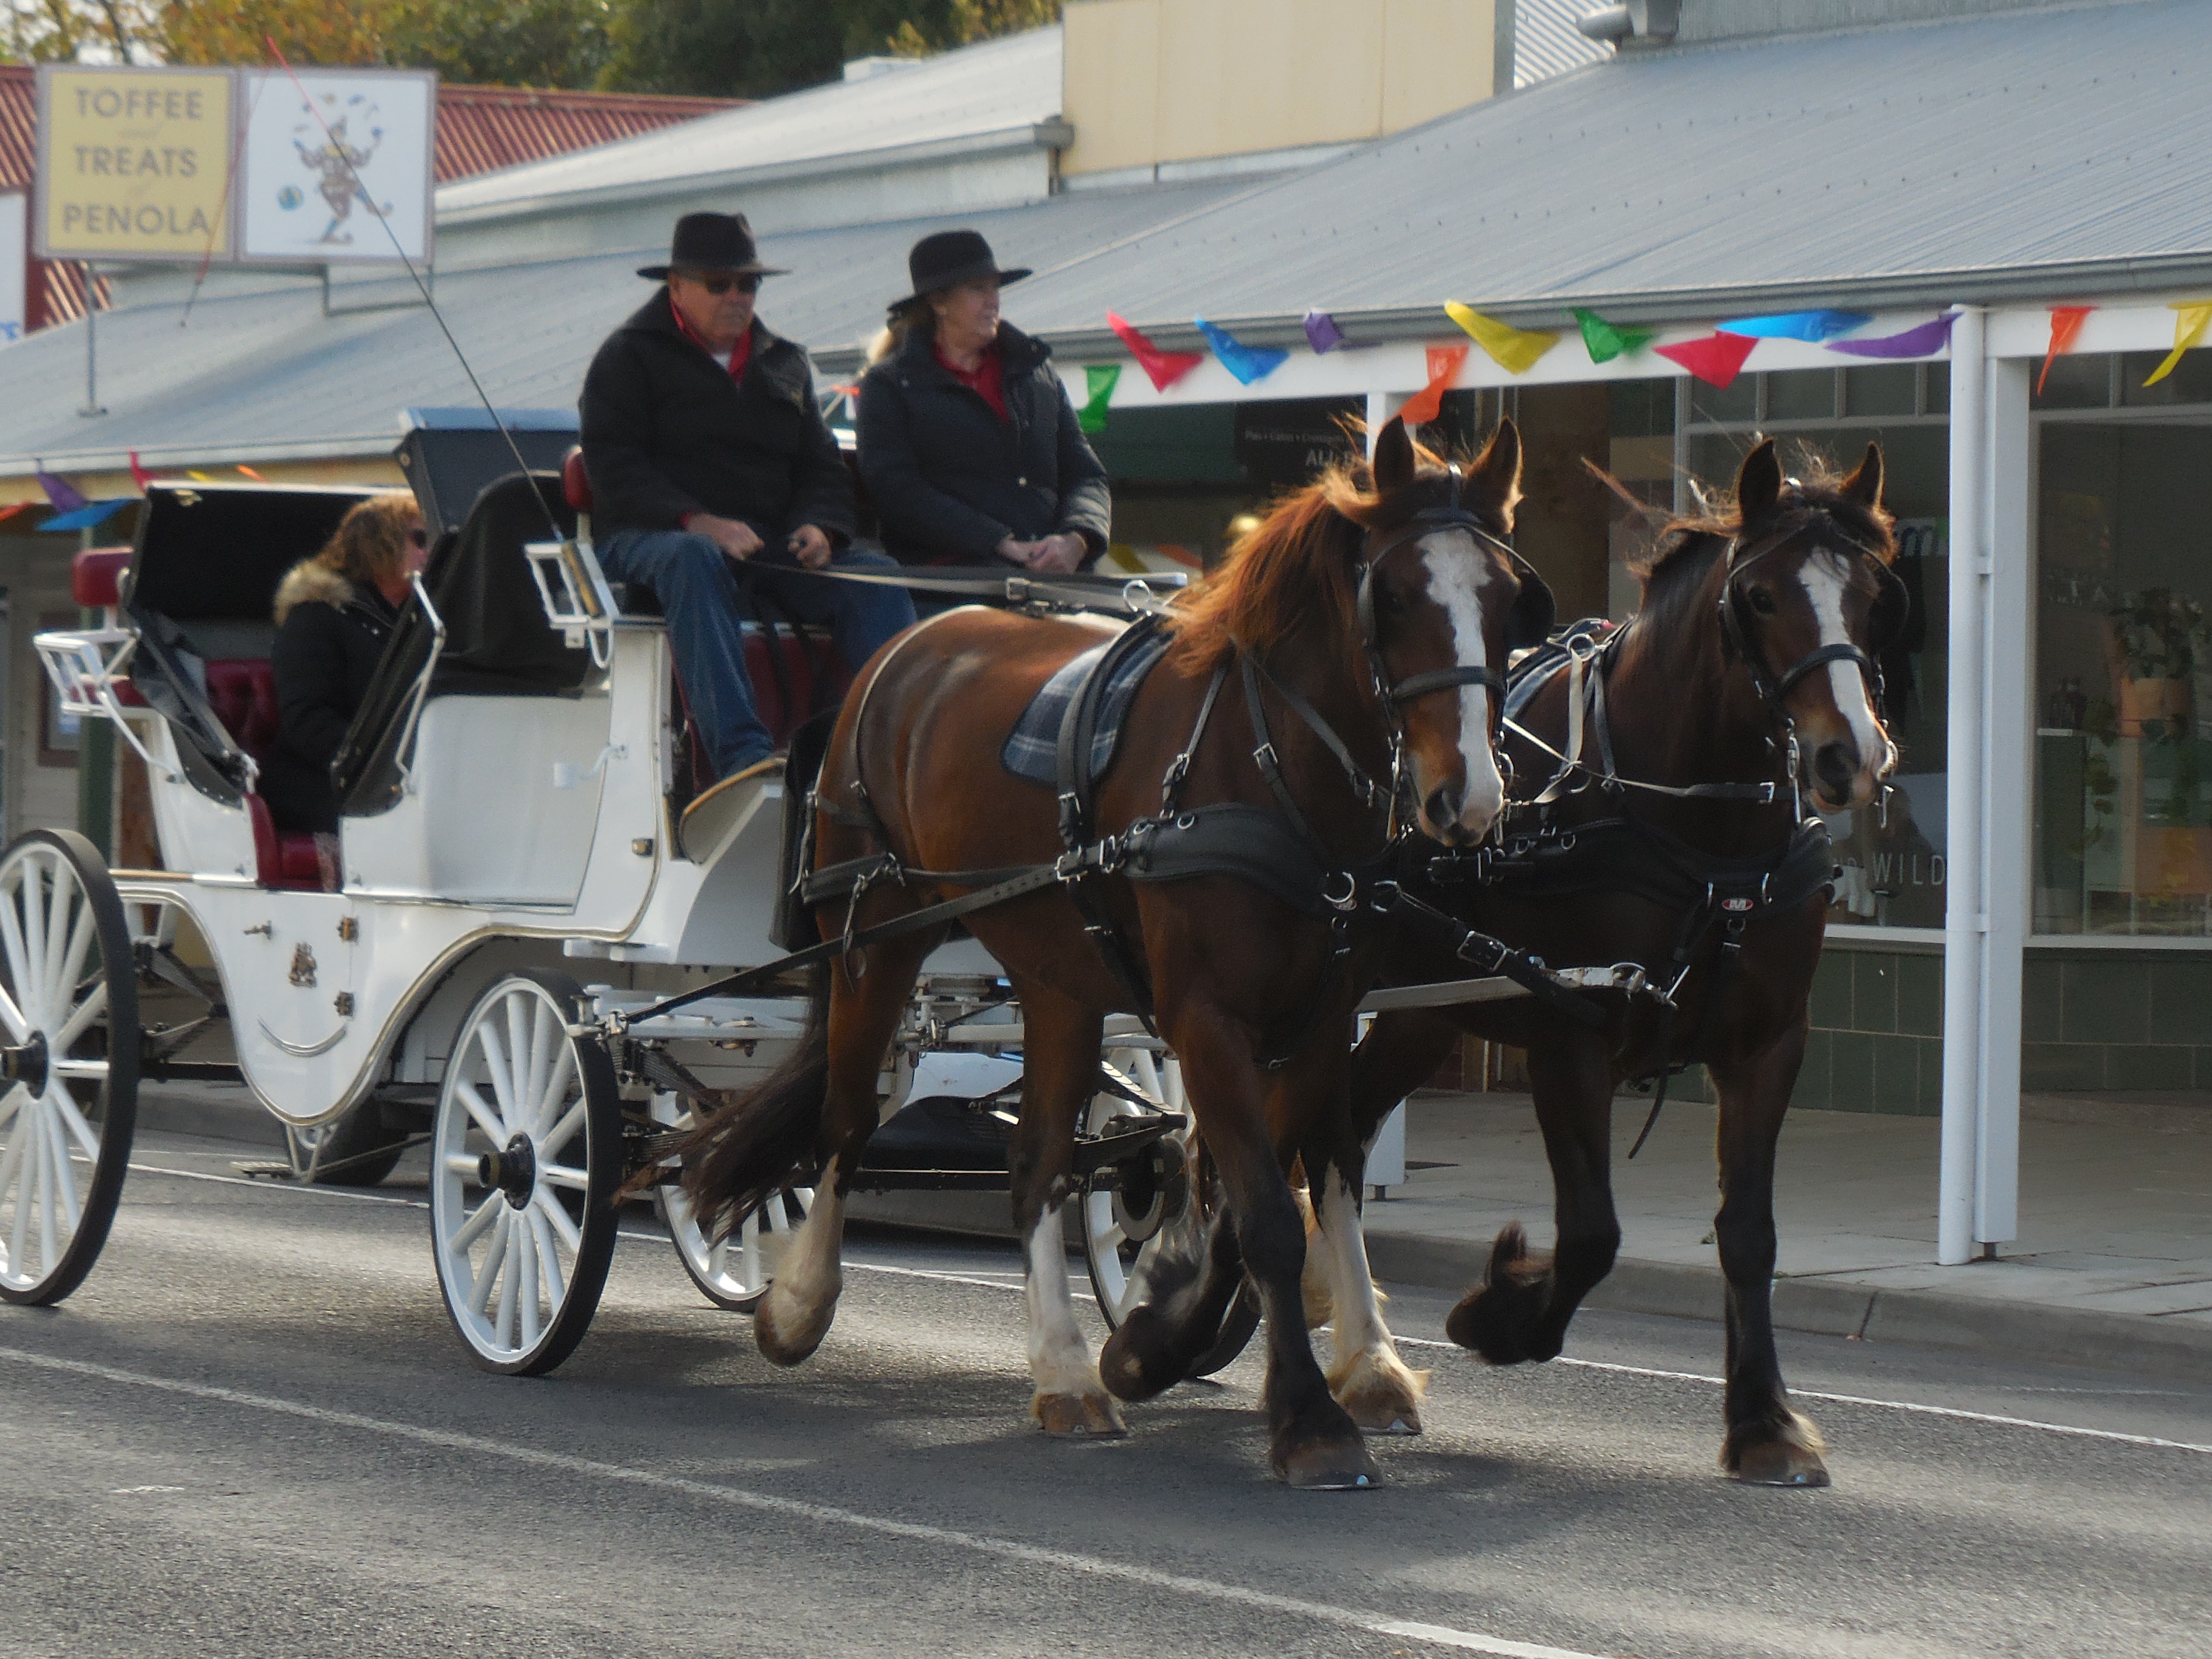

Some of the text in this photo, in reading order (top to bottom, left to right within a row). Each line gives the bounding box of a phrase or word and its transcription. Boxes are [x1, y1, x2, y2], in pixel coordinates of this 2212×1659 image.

[74, 86, 204, 119] TOFFEE
[74, 146, 199, 178] TREATS
[63, 203, 212, 235] PENOLA
[1873, 852, 1946, 885] WILD
